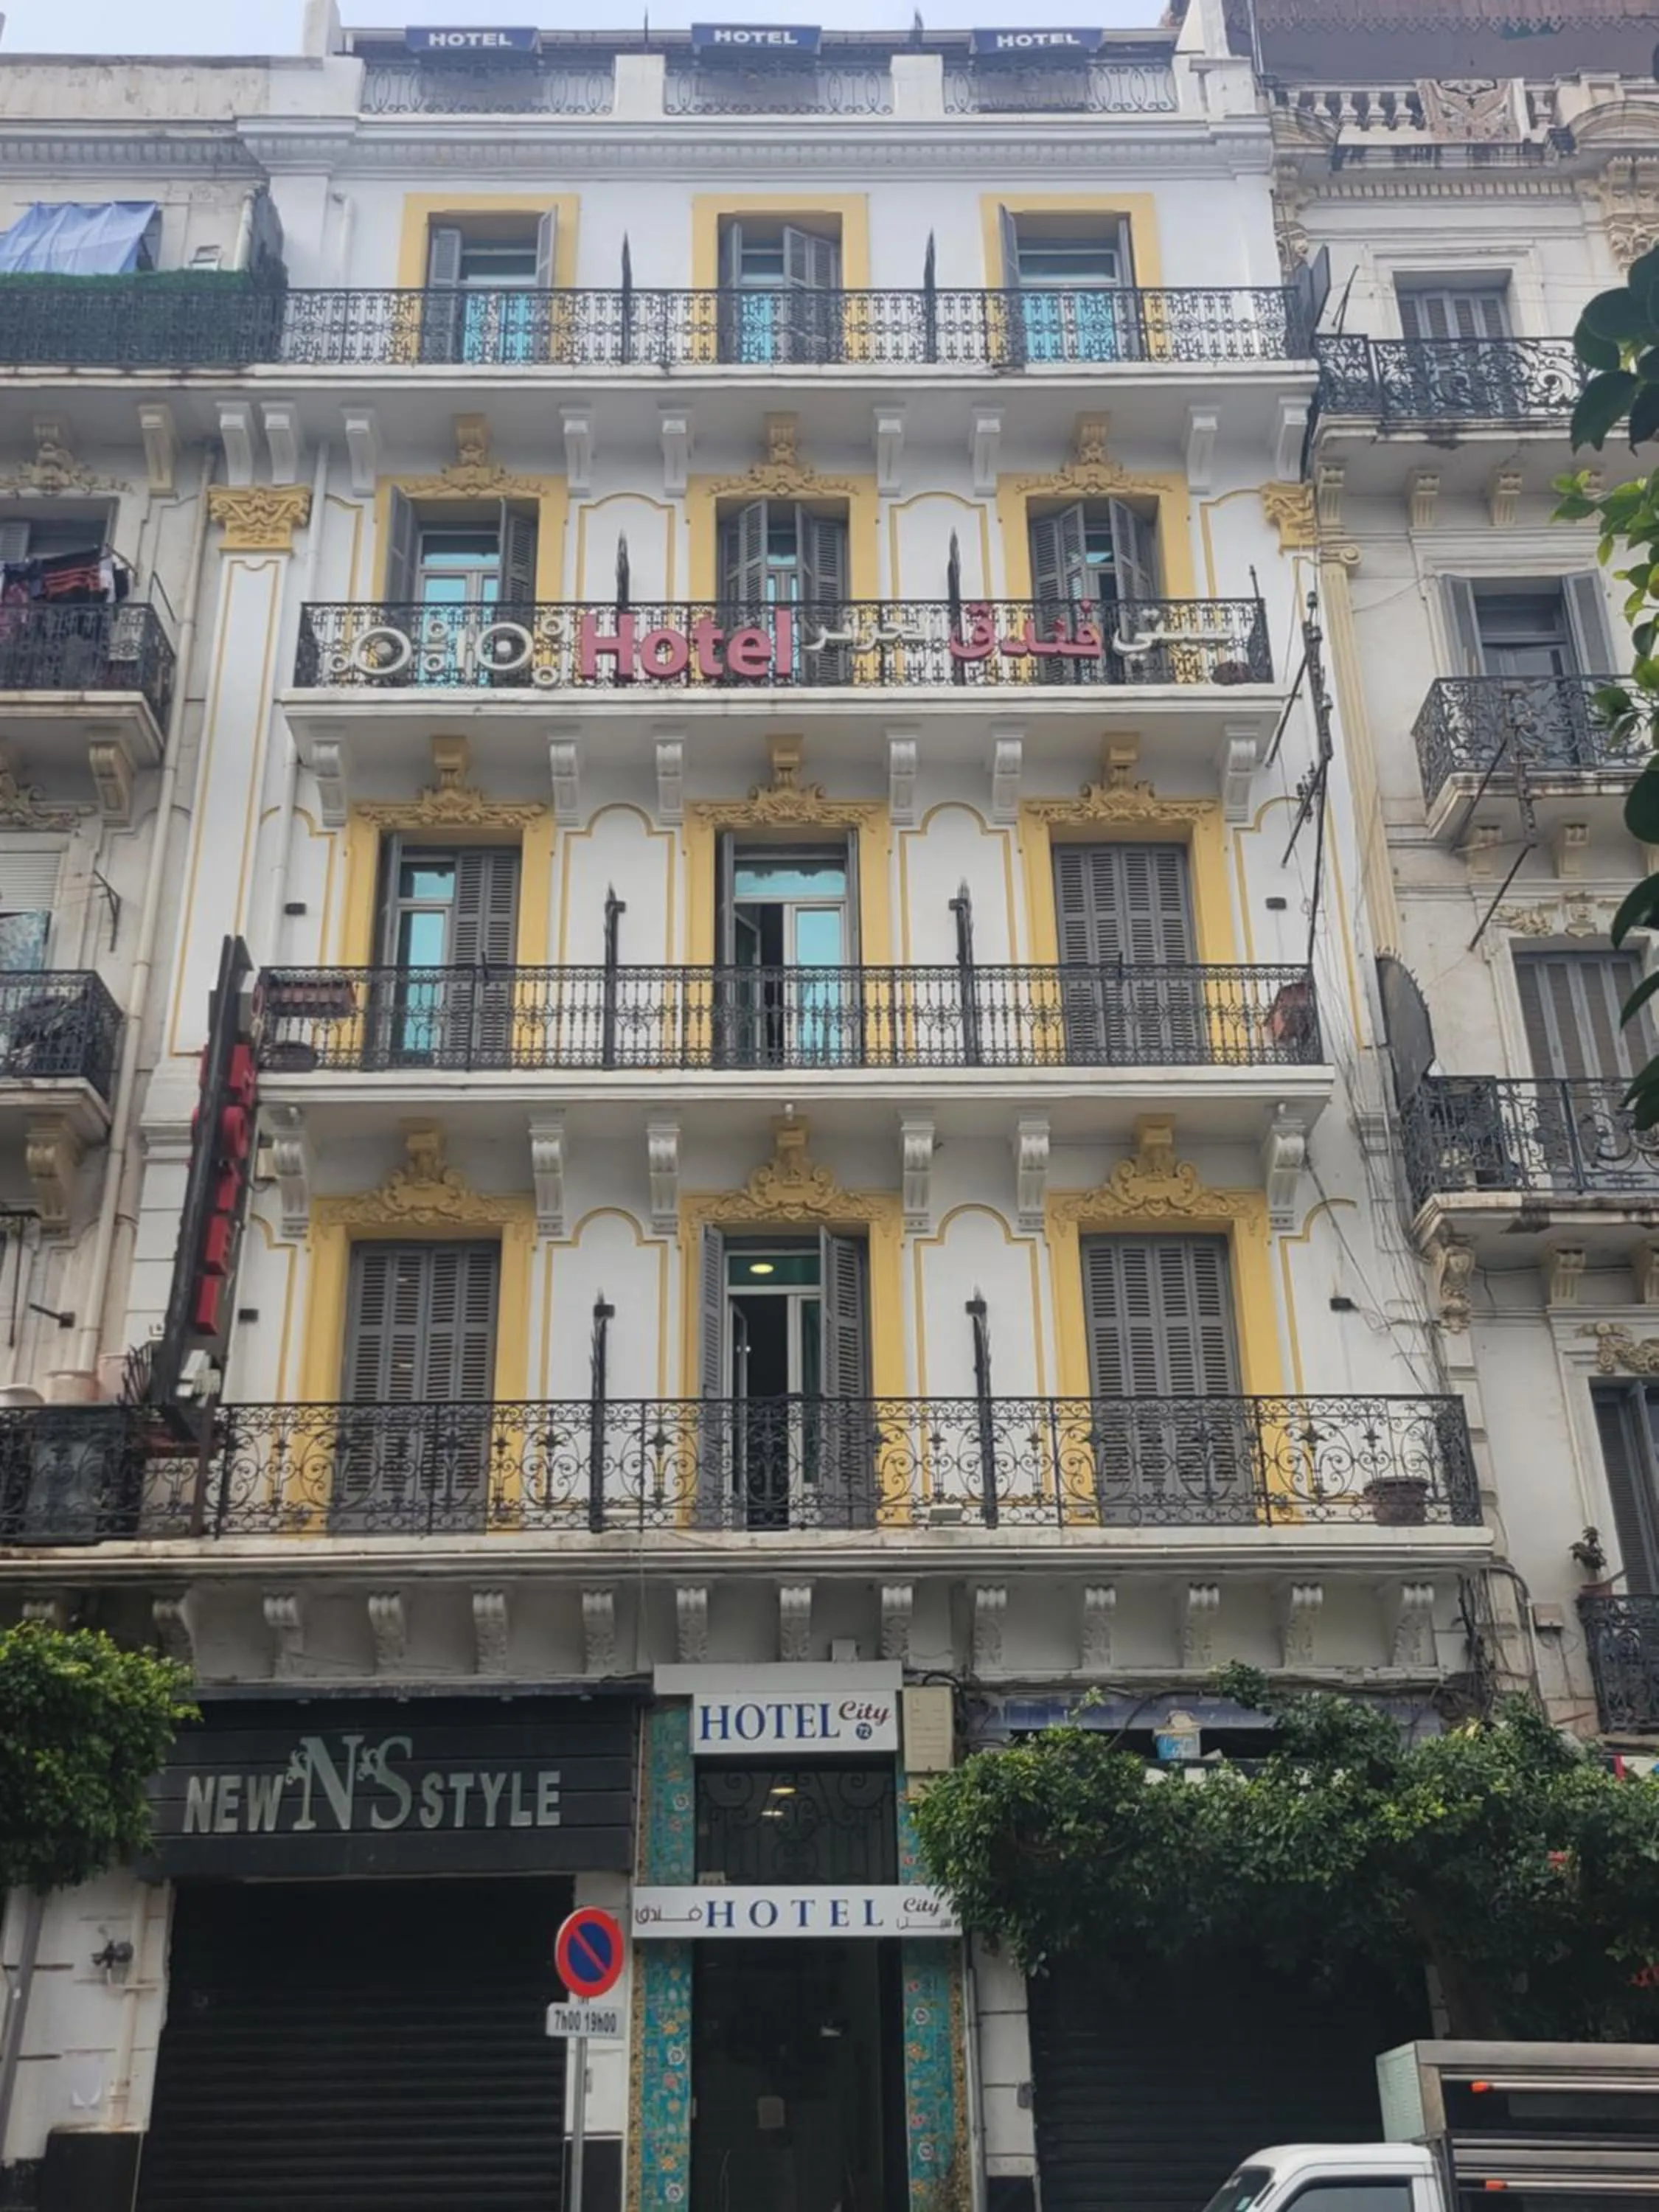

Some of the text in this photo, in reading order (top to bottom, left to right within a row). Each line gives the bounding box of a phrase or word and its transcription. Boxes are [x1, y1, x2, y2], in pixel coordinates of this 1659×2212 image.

[428, 32, 512, 46] HOTEL
[714, 29, 799, 44] HOTEL
[997, 33, 1080, 48] HOTEL
[580, 607, 793, 680] Hotel
[950, 599, 1101, 659] فندق
[698, 1700, 891, 1741] HOTEL City
[182, 1774, 285, 1834] NEW
[419, 1770, 561, 1828] STYLE
[705, 1899, 884, 1928] HOTEL
[902, 1897, 940, 1917] City
[554, 2009, 616, 2034] 7h00 19h00
